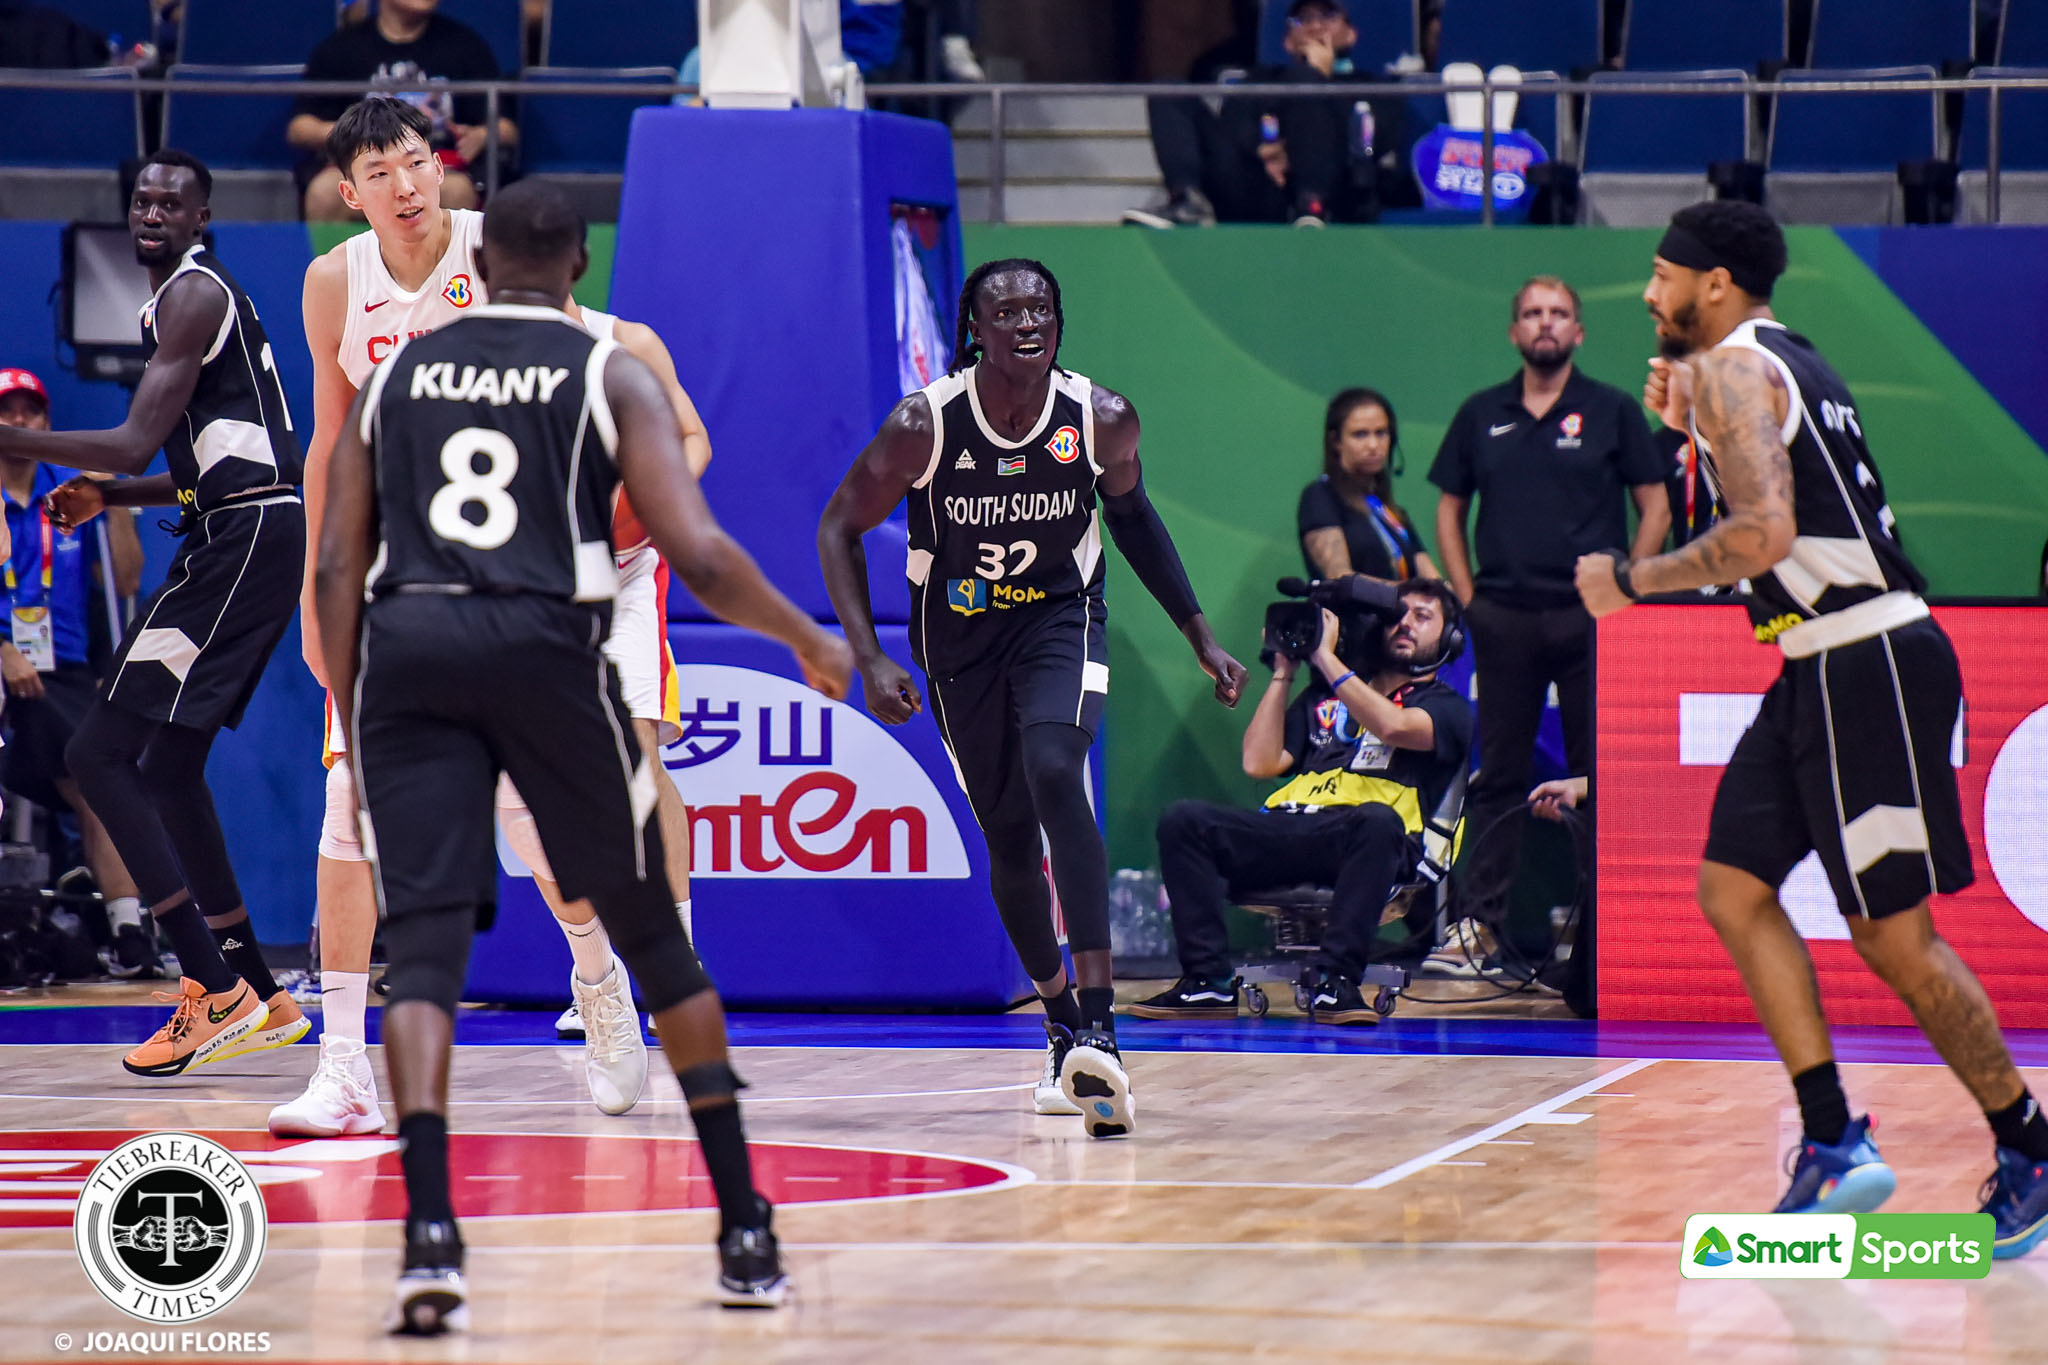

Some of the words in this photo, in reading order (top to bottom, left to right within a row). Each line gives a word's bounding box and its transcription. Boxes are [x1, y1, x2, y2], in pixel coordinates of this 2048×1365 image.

[409, 361, 570, 407] KUANY
[428, 426, 520, 551] 8
[944, 495, 1007, 528] SOUTH
[1008, 488, 1076, 523] SUDAN
